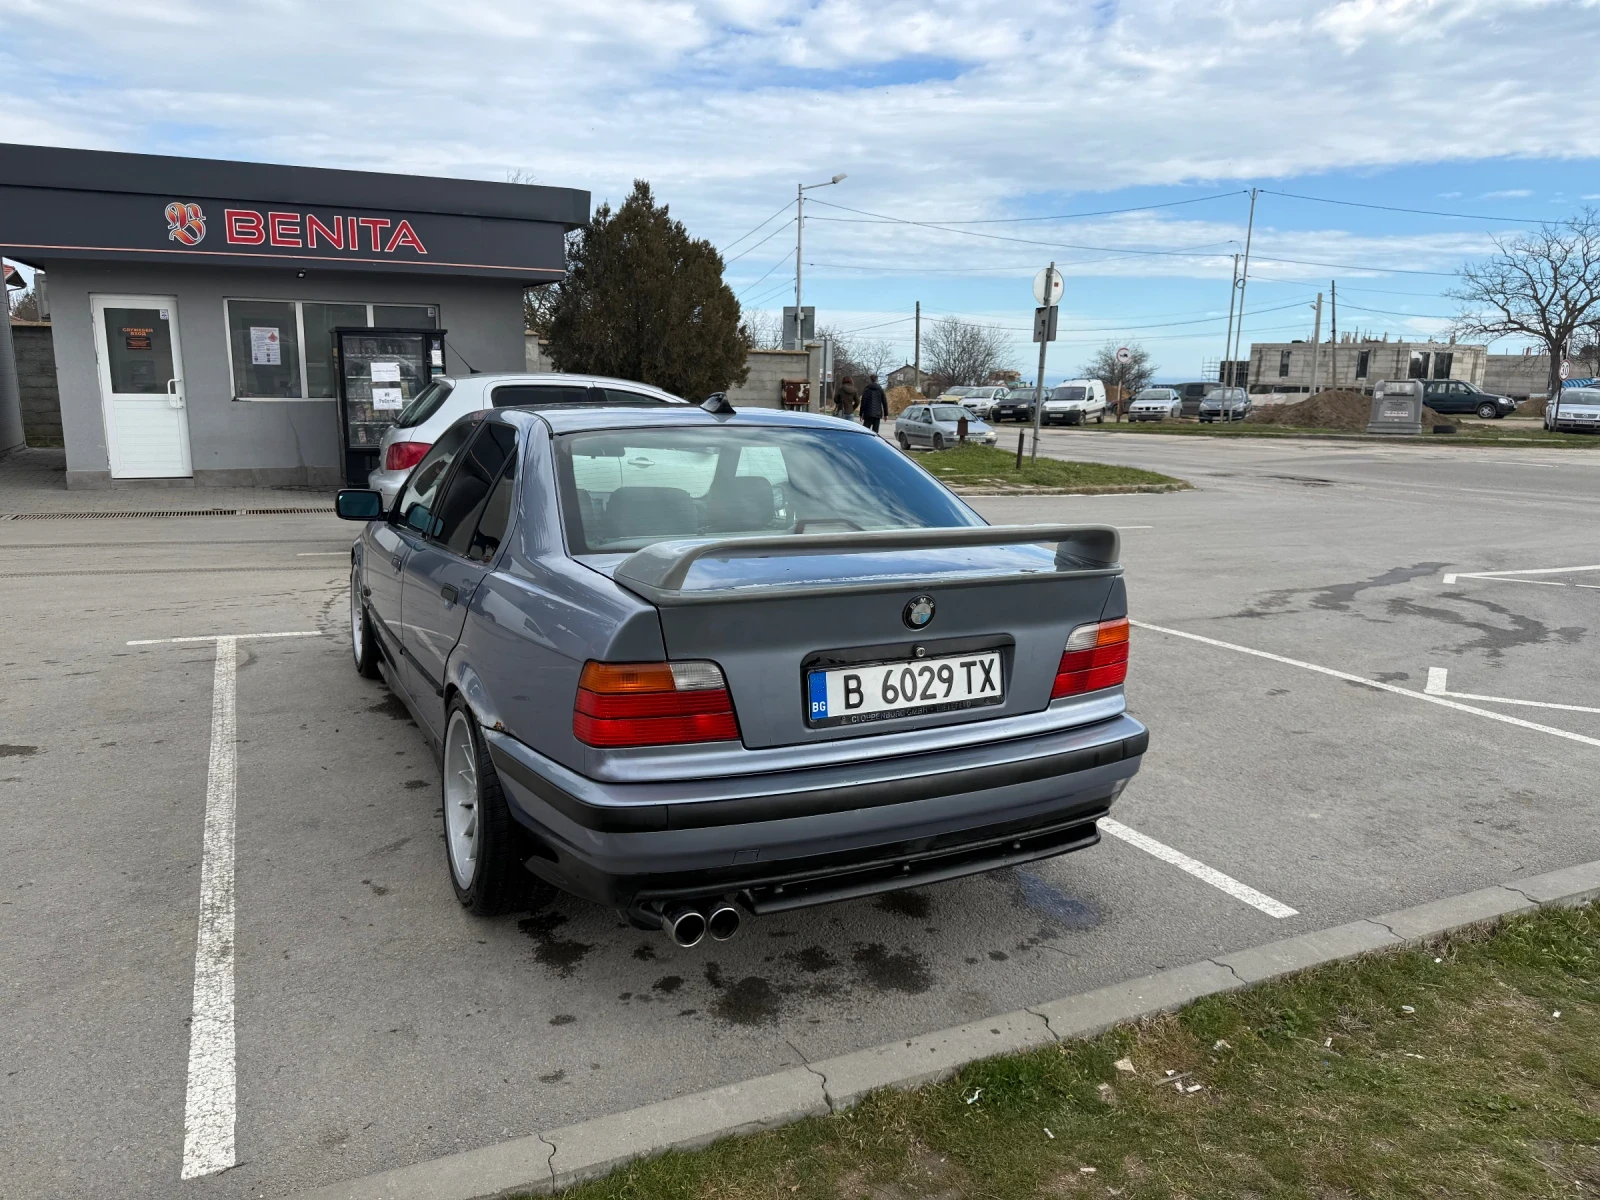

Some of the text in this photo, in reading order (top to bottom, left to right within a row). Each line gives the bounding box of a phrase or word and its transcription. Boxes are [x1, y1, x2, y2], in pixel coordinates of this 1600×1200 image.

[225, 209, 428, 254] BENITA
[910, 597, 935, 610] BMW
[843, 658, 995, 710] B 6029 TX
[812, 701, 826, 713] BG
